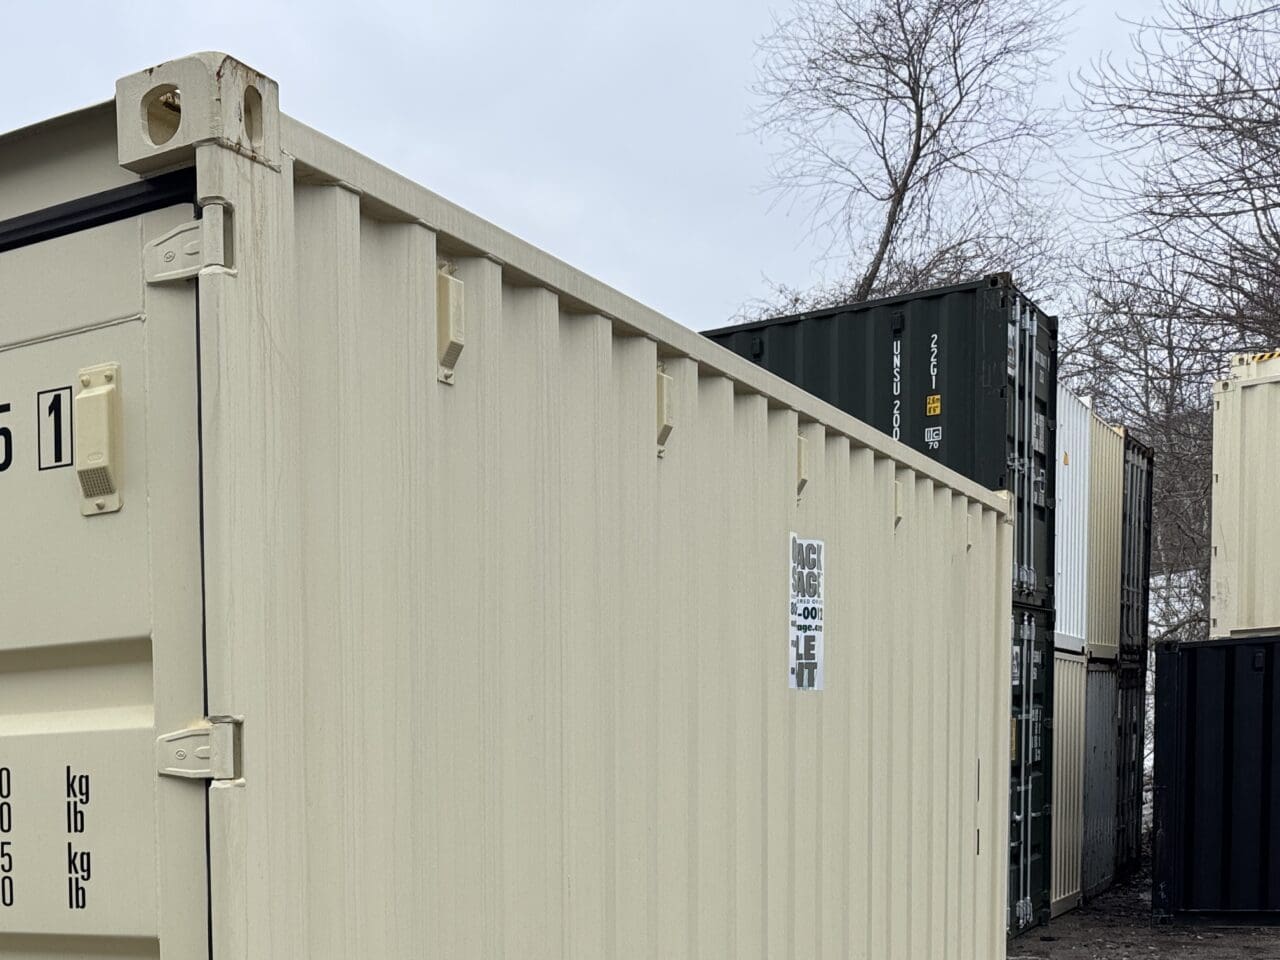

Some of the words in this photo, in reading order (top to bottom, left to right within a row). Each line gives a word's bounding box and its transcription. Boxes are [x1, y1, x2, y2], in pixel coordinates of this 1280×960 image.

[893, 340, 901, 395] UNSU
[930, 333, 938, 389] 22G1
[66, 765, 89, 804] kg
[66, 801, 84, 833] lb
[67, 842, 91, 881] kg
[68, 877, 86, 909] lb
